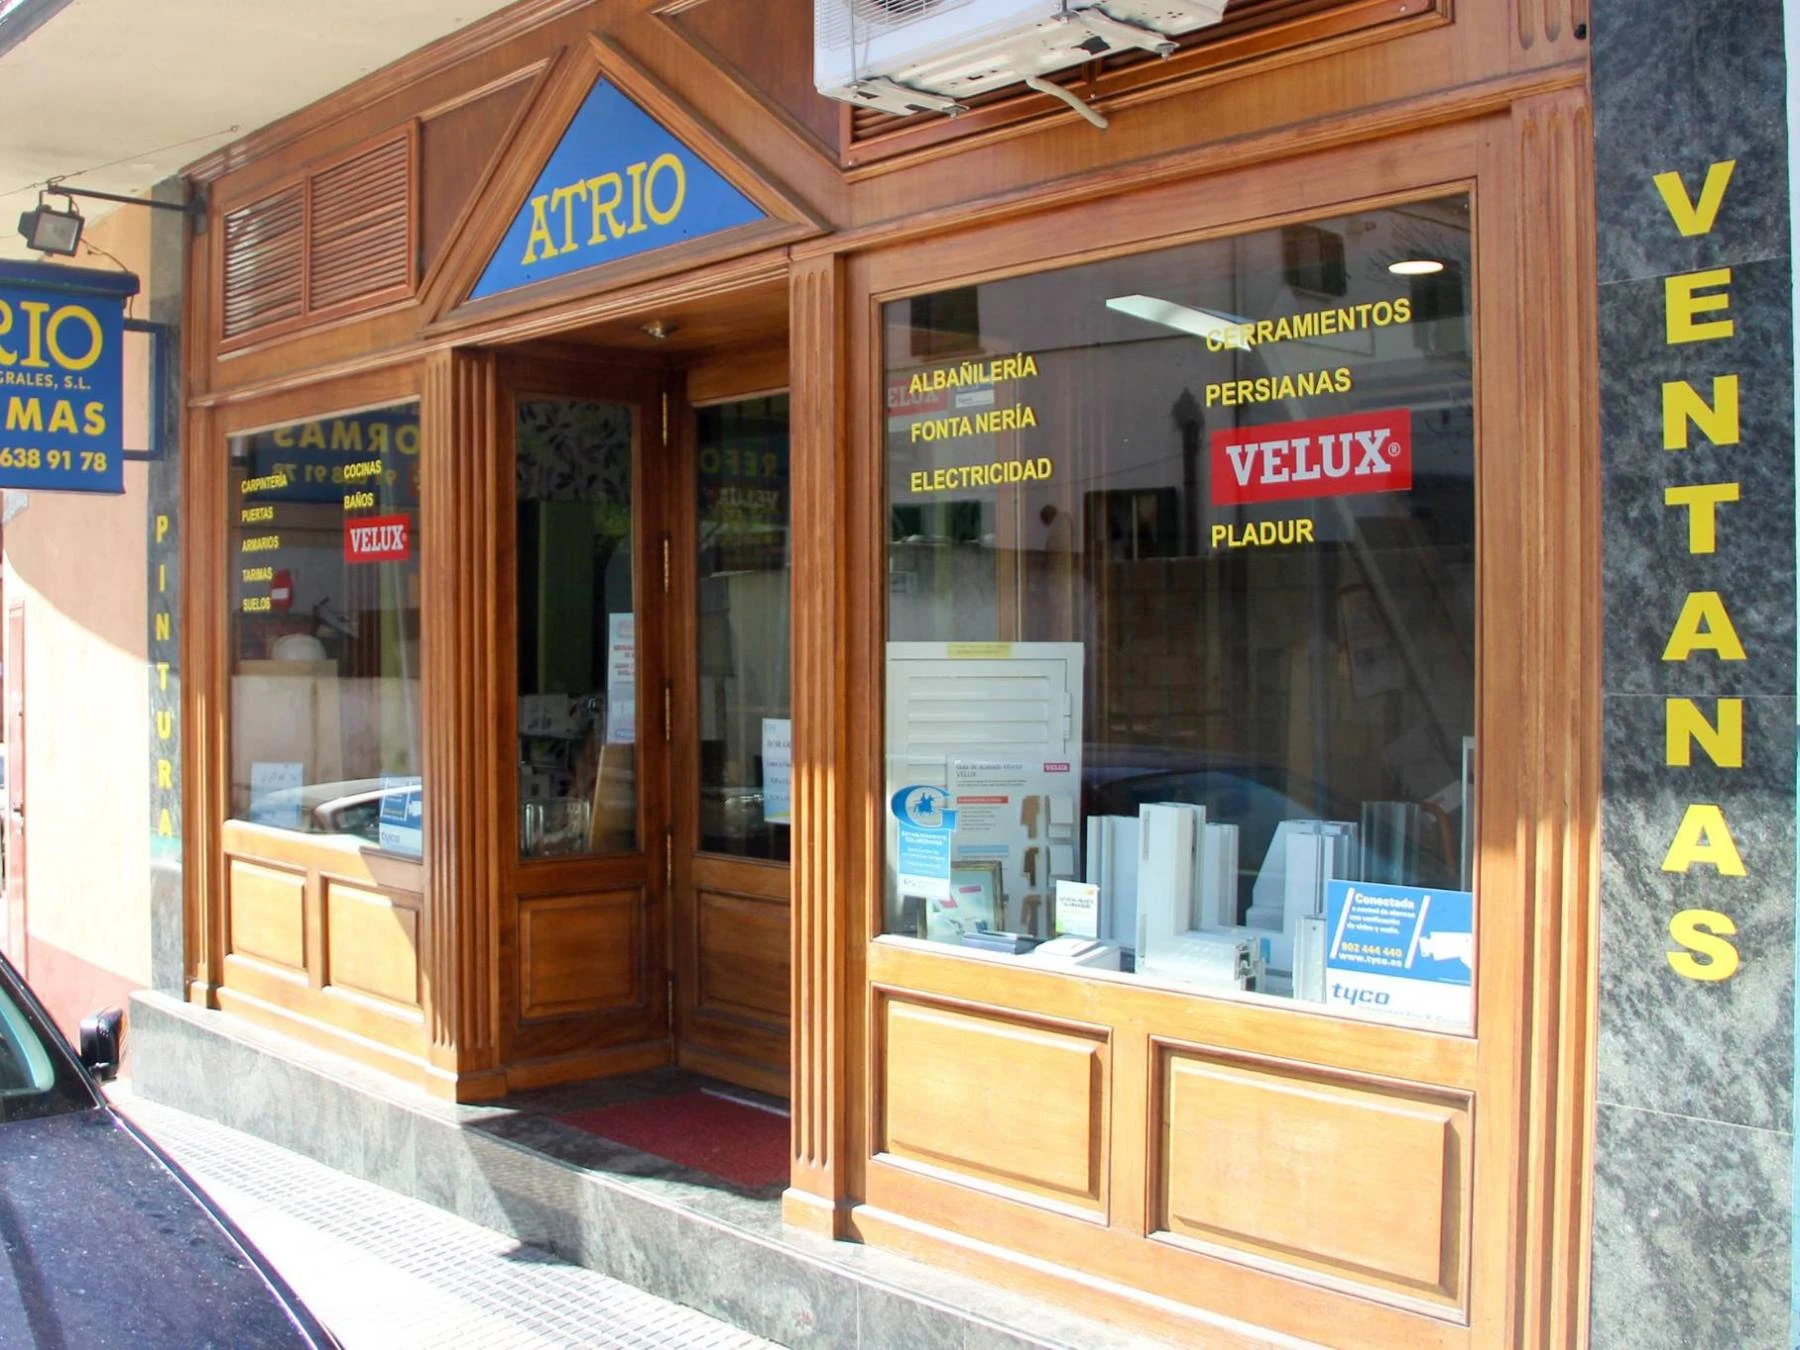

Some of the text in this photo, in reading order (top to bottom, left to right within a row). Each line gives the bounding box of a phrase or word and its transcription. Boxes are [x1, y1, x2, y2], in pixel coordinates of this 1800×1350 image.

[520, 153, 686, 265] ATRIO
[1206, 298, 1411, 352] CERRAMIENTOS
[64, 376, 91, 390] S.L.
[909, 352, 1037, 394] ALBAÑILERÍA
[1206, 368, 1351, 407] PERSIANAS
[6, 397, 106, 436] MAS
[0, 447, 107, 471] 638 91 78
[344, 459, 382, 478] COCINAS
[241, 472, 288, 494] CARPINTERÍA
[910, 458, 1052, 492] ELECTRICIDAD
[344, 492, 374, 510] BAÑOS
[242, 506, 273, 522] PUERTAS
[242, 536, 279, 552] ARMARIOS
[1211, 519, 1314, 547] PLADUR
[1652, 159, 1747, 981] VENTANAS
[243, 597, 271, 613] SUELOS
[156, 515, 173, 837] PINTURA
[1355, 893, 1415, 910] Conectada
[1341, 941, 1360, 953] 902
[1332, 982, 1390, 1005] tyco
